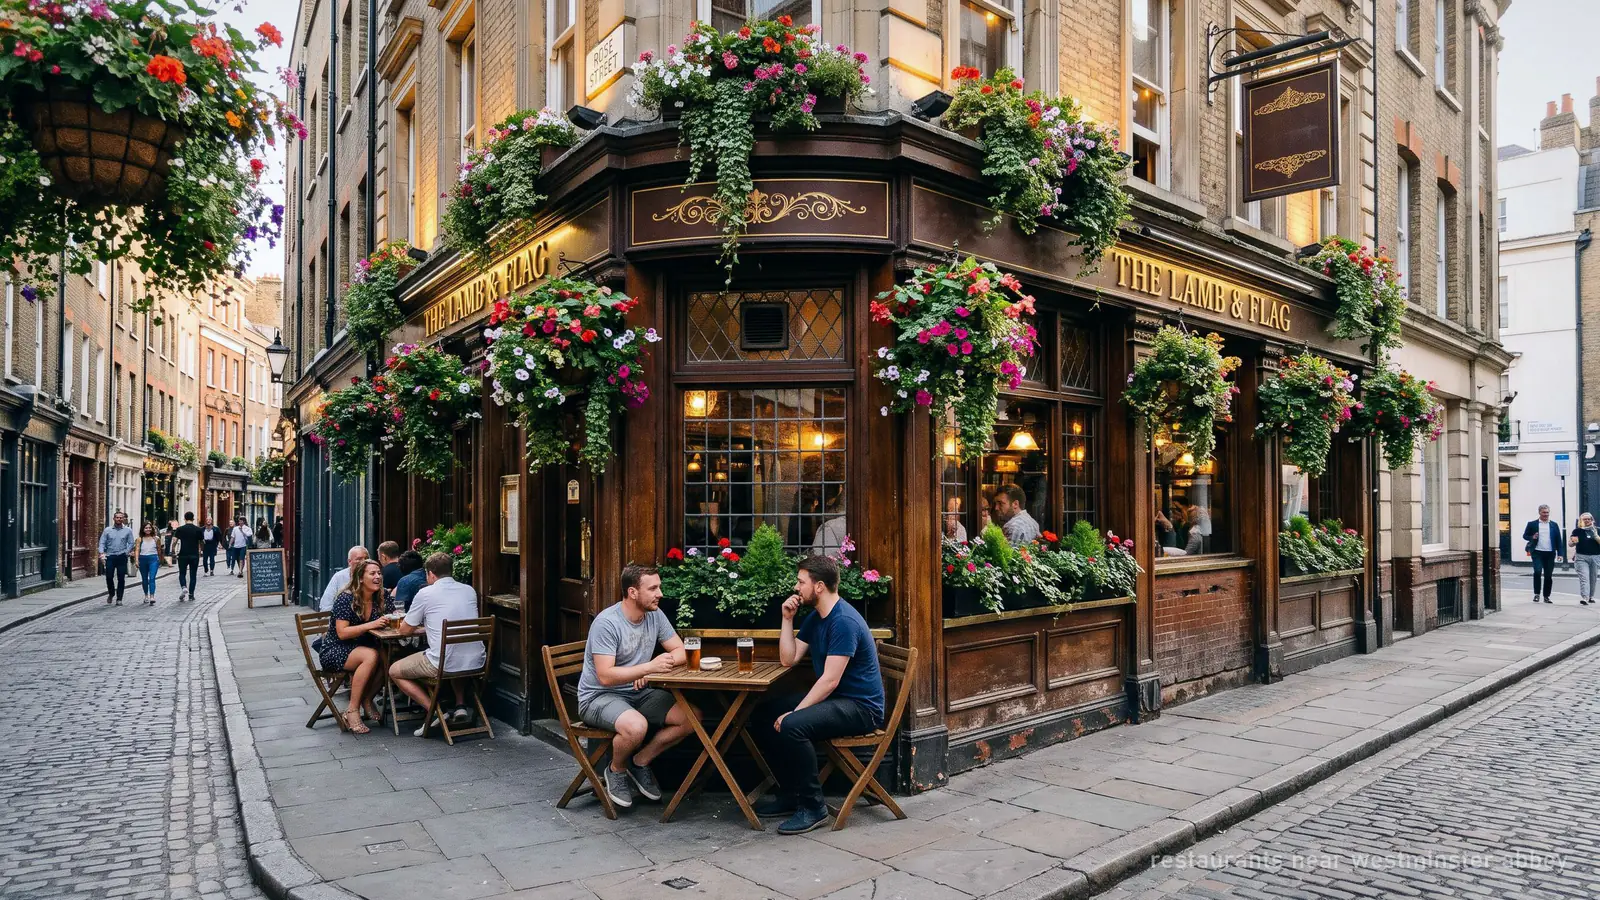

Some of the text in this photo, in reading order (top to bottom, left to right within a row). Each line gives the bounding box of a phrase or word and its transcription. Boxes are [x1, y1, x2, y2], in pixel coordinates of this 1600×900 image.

[589, 51, 618, 88] STREET
[593, 37, 613, 69] ROSE
[424, 241, 549, 338] THE LAMB & FLAG
[1113, 251, 1292, 333] THE LAMB & FLAG
